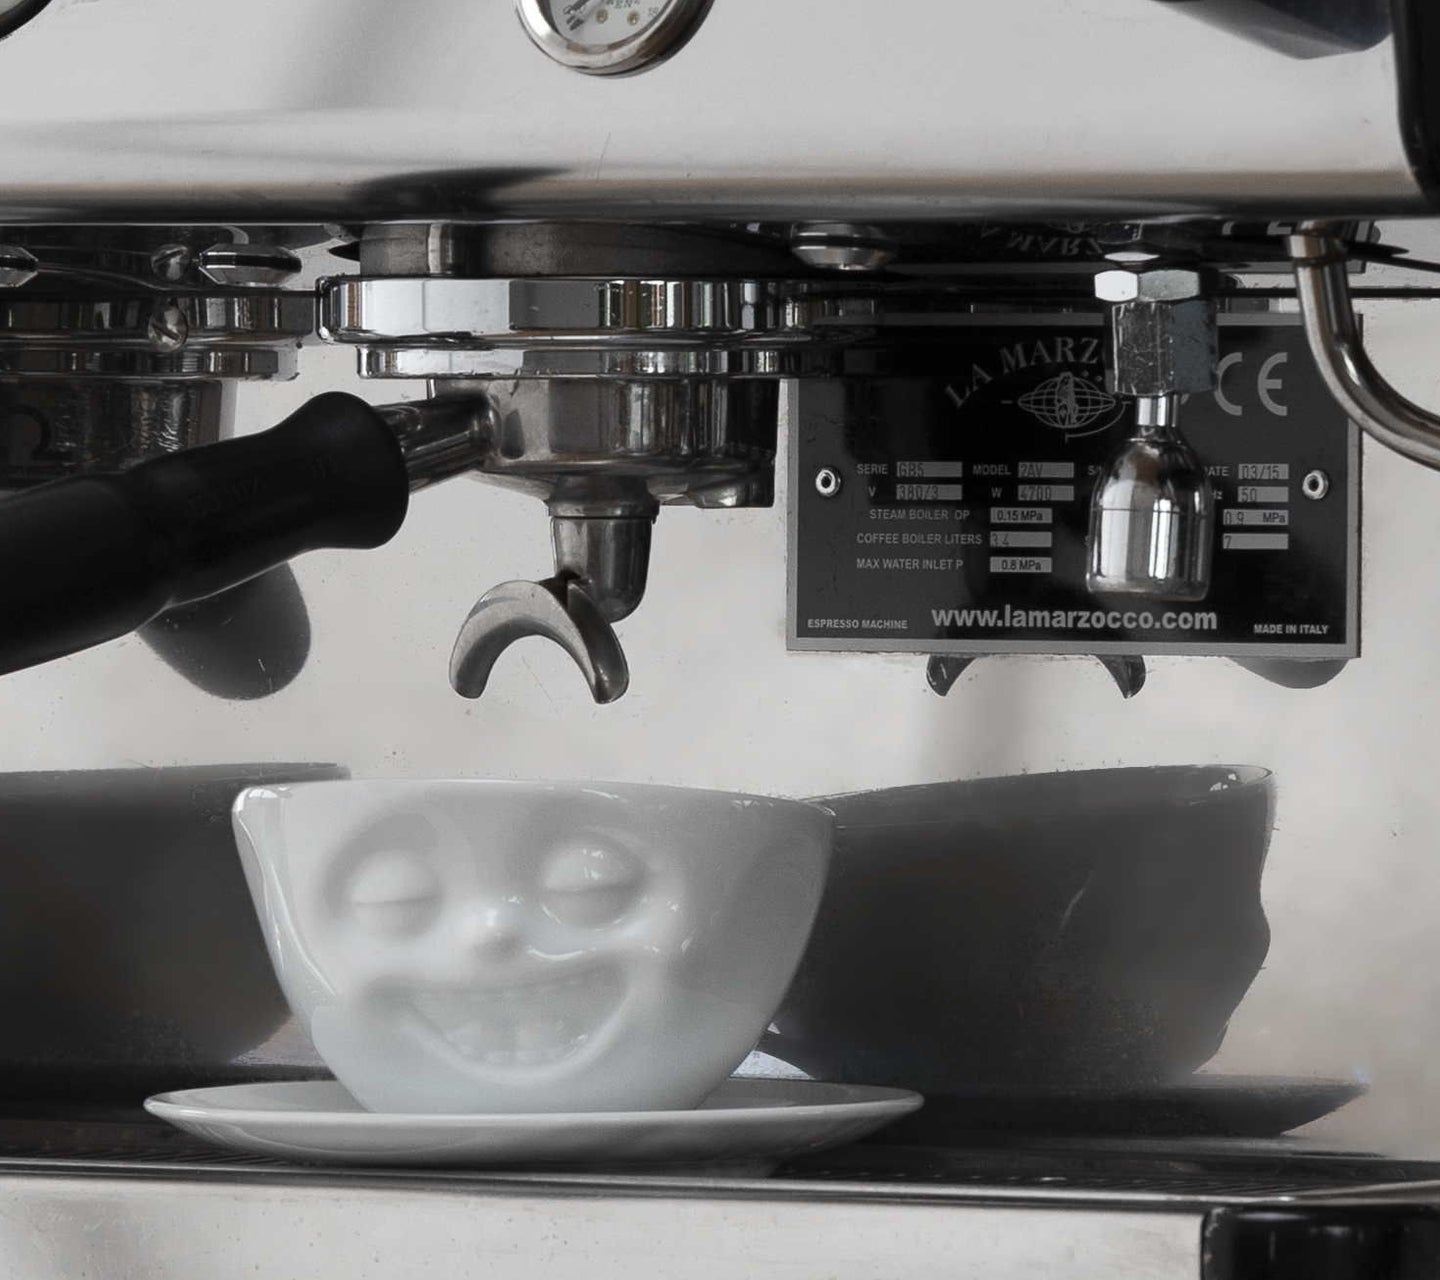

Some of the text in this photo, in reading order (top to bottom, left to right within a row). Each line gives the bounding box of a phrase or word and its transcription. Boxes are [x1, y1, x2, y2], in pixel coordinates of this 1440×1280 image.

[945, 362, 992, 409] LA
[856, 463, 888, 475] SERIE
[972, 464, 1012, 476] MODEL
[1205, 466, 1230, 477] ATE
[869, 486, 877, 497] V
[991, 486, 1003, 498] W
[1239, 487, 1258, 502] 50
[869, 508, 907, 520] STEAM
[909, 509, 949, 521] BOILER
[996, 509, 1019, 522] 0.15
[1021, 510, 1043, 522] MPa
[1263, 511, 1286, 523] MPa
[856, 532, 899, 544] COFFEE
[901, 533, 942, 545] BOILER
[944, 534, 982, 546] LITERS
[856, 557, 1042, 571] MAX WATER INLET P 0.8 MPa
[931, 603, 1218, 630] www.lamarzocco.com
[807, 619, 908, 630] ESPRESSO MACHINE
[1253, 623, 1329, 635] MADE IN ITALY
